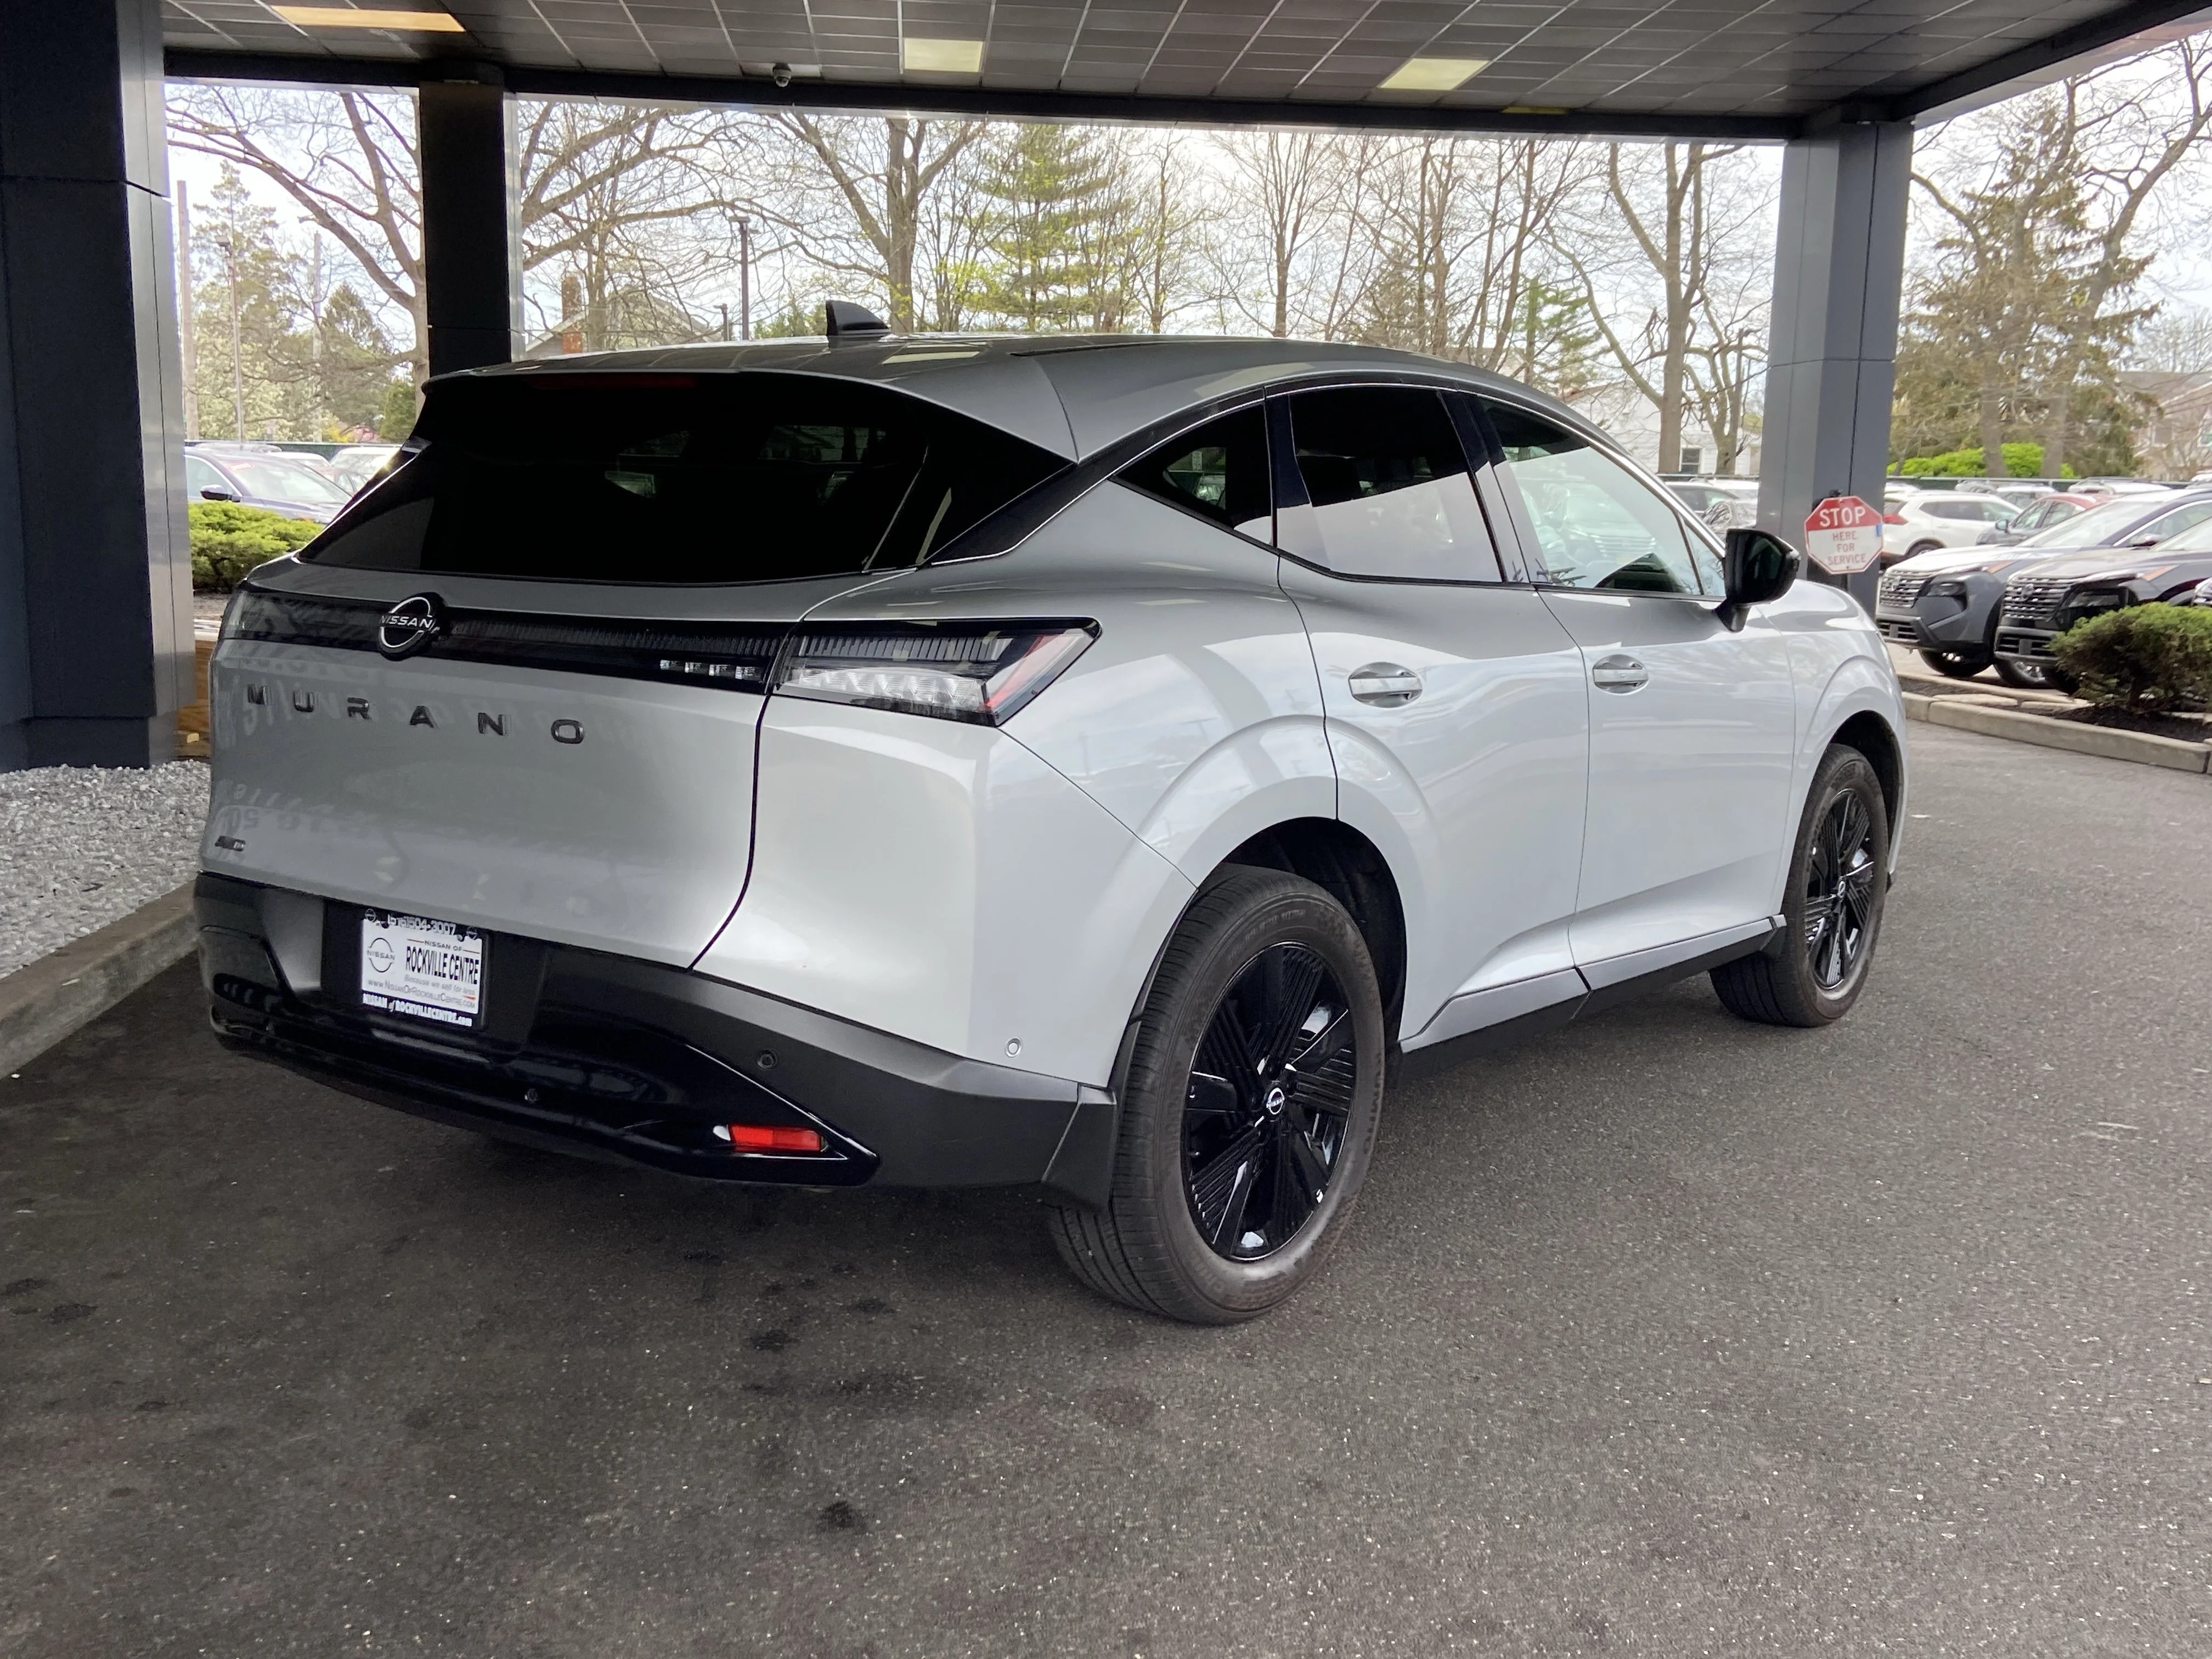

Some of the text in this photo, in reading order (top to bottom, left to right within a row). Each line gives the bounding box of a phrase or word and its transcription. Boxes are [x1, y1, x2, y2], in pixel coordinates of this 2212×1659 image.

[1819, 506, 1866, 527] STOP
[1832, 531, 1858, 541] HERE
[1837, 543, 1855, 552] FOR
[1827, 554, 1867, 565] SERVICE
[380, 615, 433, 629] NISSAN
[247, 684, 586, 745] MURANO
[424, 940, 451, 950] NISSAN
[366, 950, 396, 961] NISSAN
[405, 946, 479, 985] ROCKVILLE CENTRE
[453, 984, 462, 993] for
